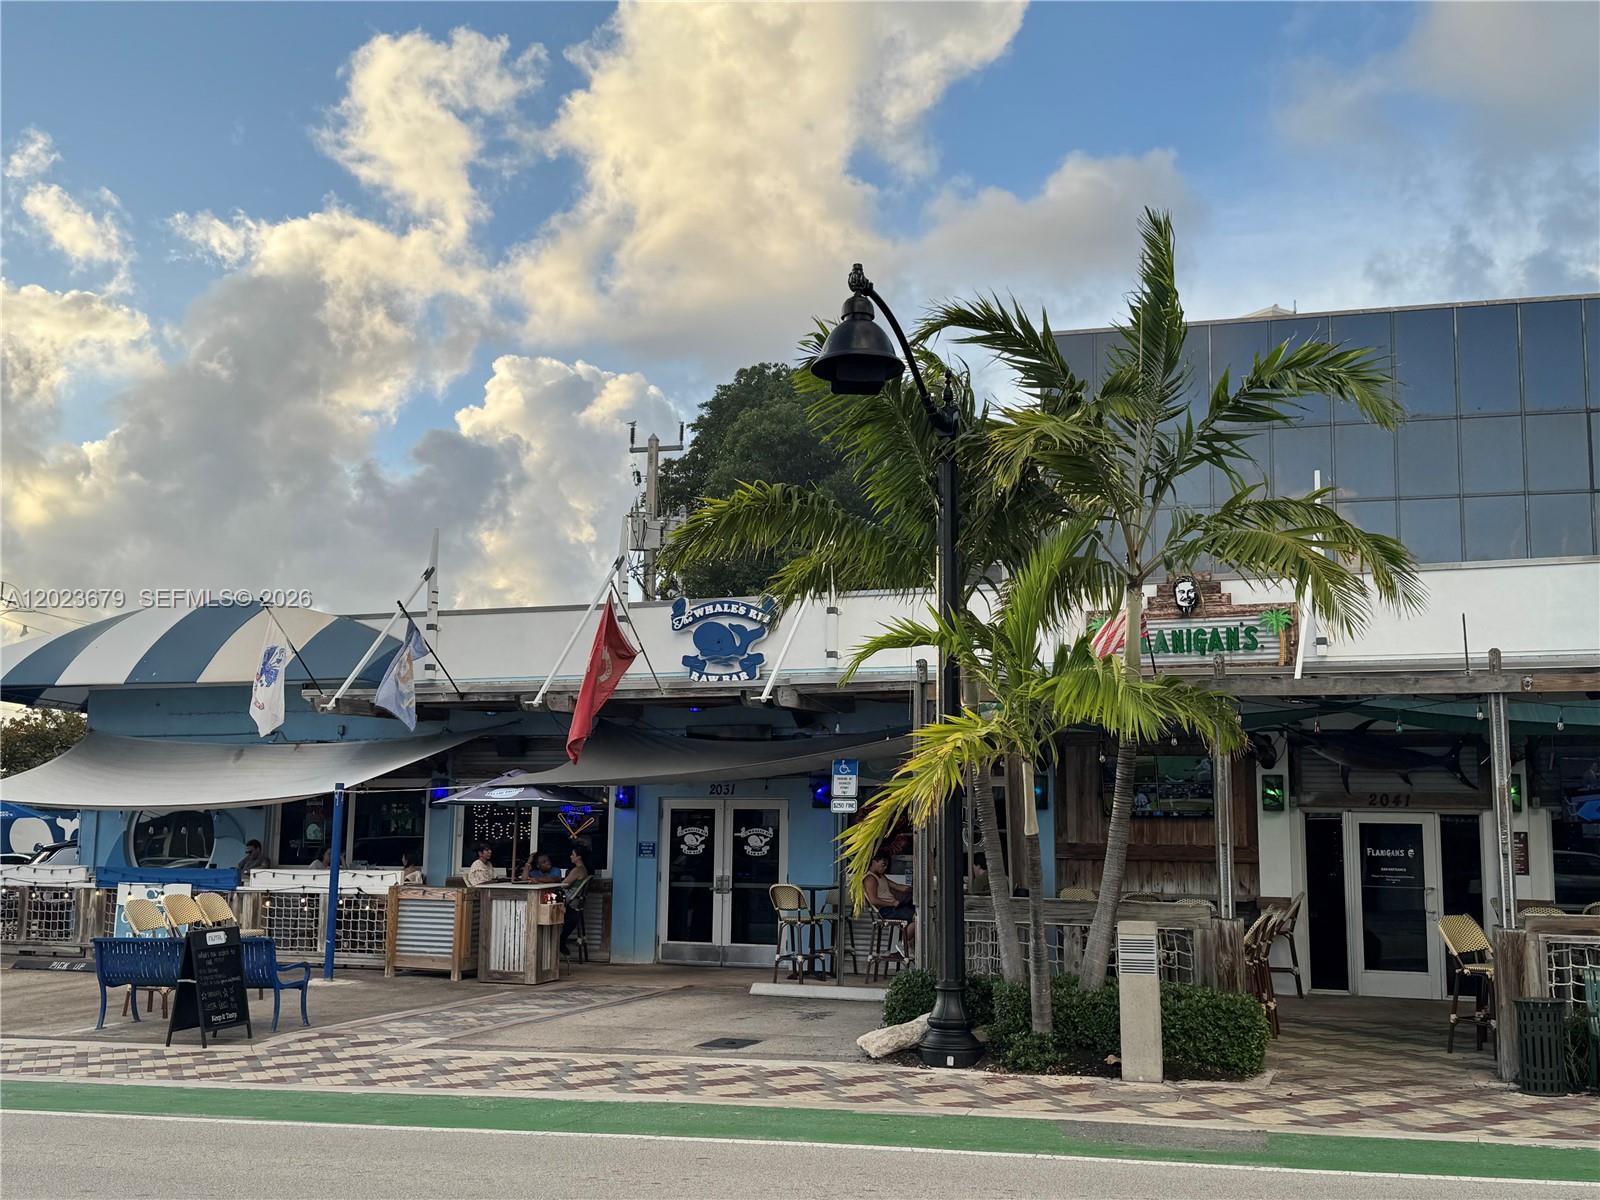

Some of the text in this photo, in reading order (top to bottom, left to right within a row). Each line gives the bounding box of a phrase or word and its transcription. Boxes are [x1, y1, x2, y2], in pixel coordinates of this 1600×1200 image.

[693, 602, 747, 618] WHALE'S
[1140, 622, 1265, 657] LANIGAN'S.
[709, 783, 736, 795] 2031
[1368, 793, 1411, 807] 2041
[49, 961, 86, 970] PICK UP
